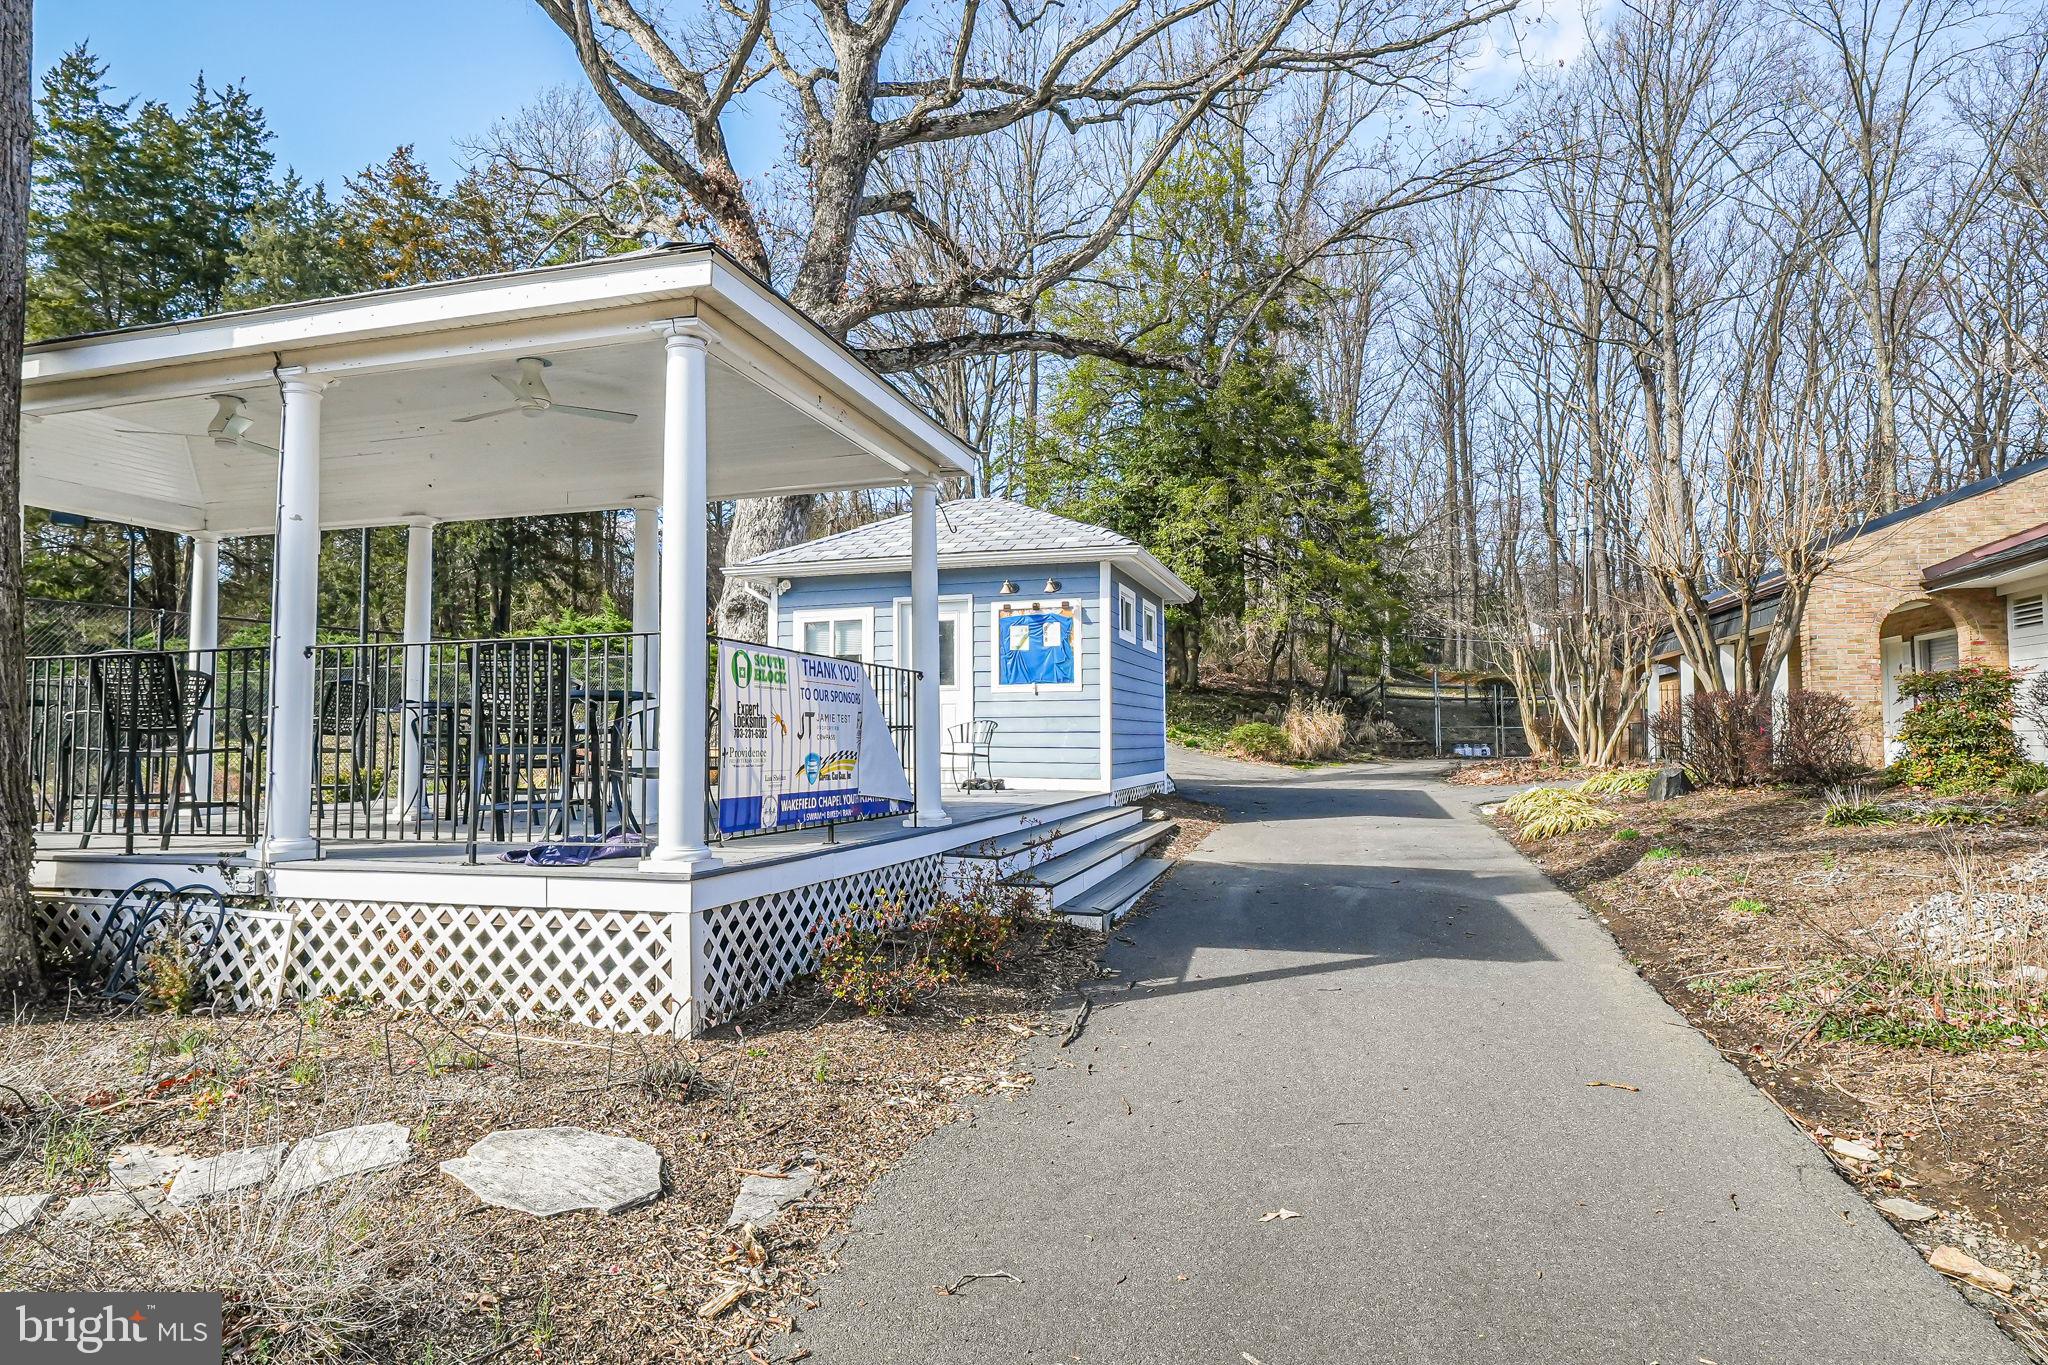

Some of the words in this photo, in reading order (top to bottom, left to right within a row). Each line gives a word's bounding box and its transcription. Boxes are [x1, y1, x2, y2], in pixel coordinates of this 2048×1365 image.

[754, 653, 785, 670] SOUTH
[754, 668, 786, 684] BLOCK
[802, 658, 837, 680] THANK
[837, 663, 859, 683] YOU!
[800, 687, 811, 701] TO
[813, 689, 830, 703] OUR
[830, 691, 861, 705] SPONSORS
[736, 700, 760, 717] Expert
[733, 712, 768, 729] Locksmith
[816, 713, 836, 723] JAMIE
[837, 714, 852, 724] TEST
[728, 746, 767, 758] Providence
[781, 797, 817, 812] WAKEFIELD
[818, 795, 842, 808] CHAPEL
